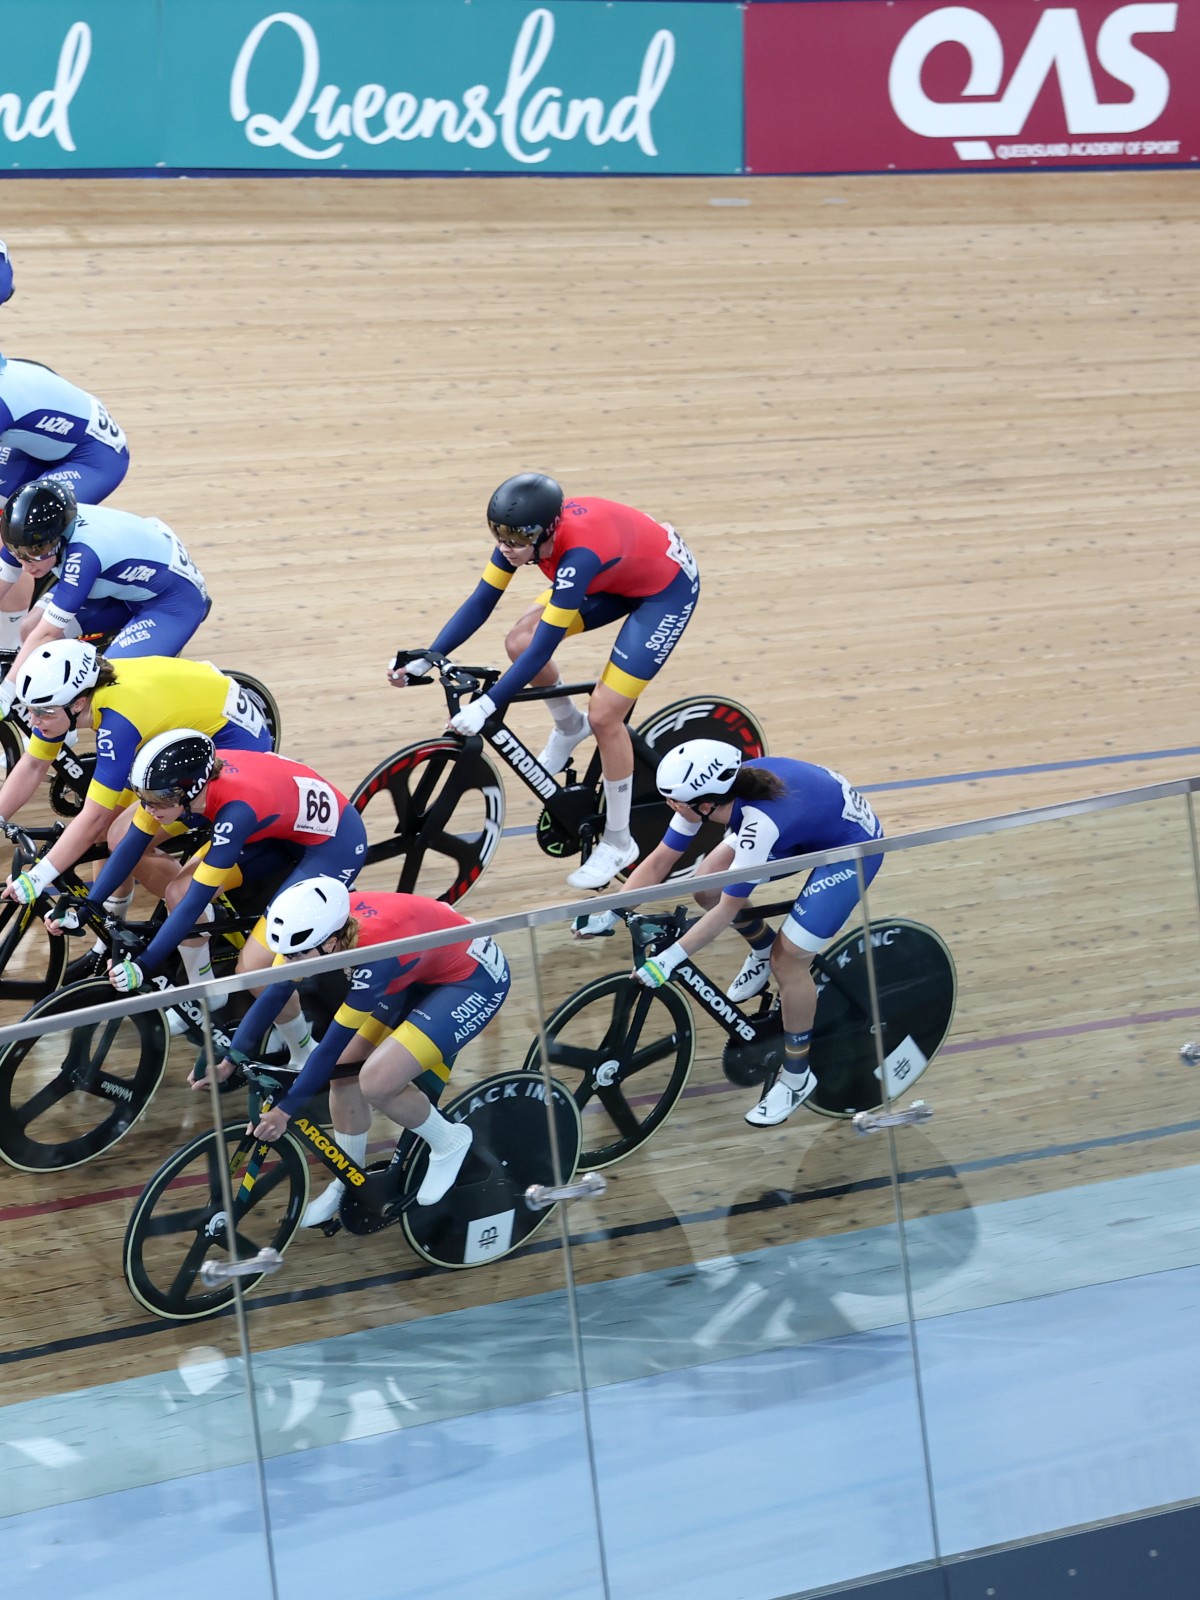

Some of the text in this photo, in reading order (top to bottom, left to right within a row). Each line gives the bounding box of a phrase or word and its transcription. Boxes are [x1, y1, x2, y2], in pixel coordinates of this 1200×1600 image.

[230, 8, 675, 163] Queensland
[888, 2, 1178, 138] QAS
[35, 415, 76, 436] LAZER
[63, 552, 83, 587] NSW
[117, 565, 158, 583] LAZER
[555, 565, 577, 591] SA
[117, 629, 152, 649] WALES
[645, 613, 679, 652] SOUTH
[653, 601, 694, 665] AUSTRALIA
[71, 652, 93, 690] KASK
[97, 727, 117, 761] ACT
[62, 757, 85, 780] 18
[490, 728, 558, 800] STROMM
[689, 757, 725, 791] KASK
[306, 789, 332, 824] 66
[212, 821, 234, 847] SA
[739, 821, 759, 851] VIC
[801, 867, 858, 898] VICTORIA
[350, 967, 374, 991] SA
[450, 991, 488, 1024] SOUTH
[453, 990, 505, 1044] AUSTRALIA
[676, 965, 757, 1042] ARGON 18
[452, 1081, 520, 1123] LACK
[294, 1117, 367, 1188] ARGON 18
